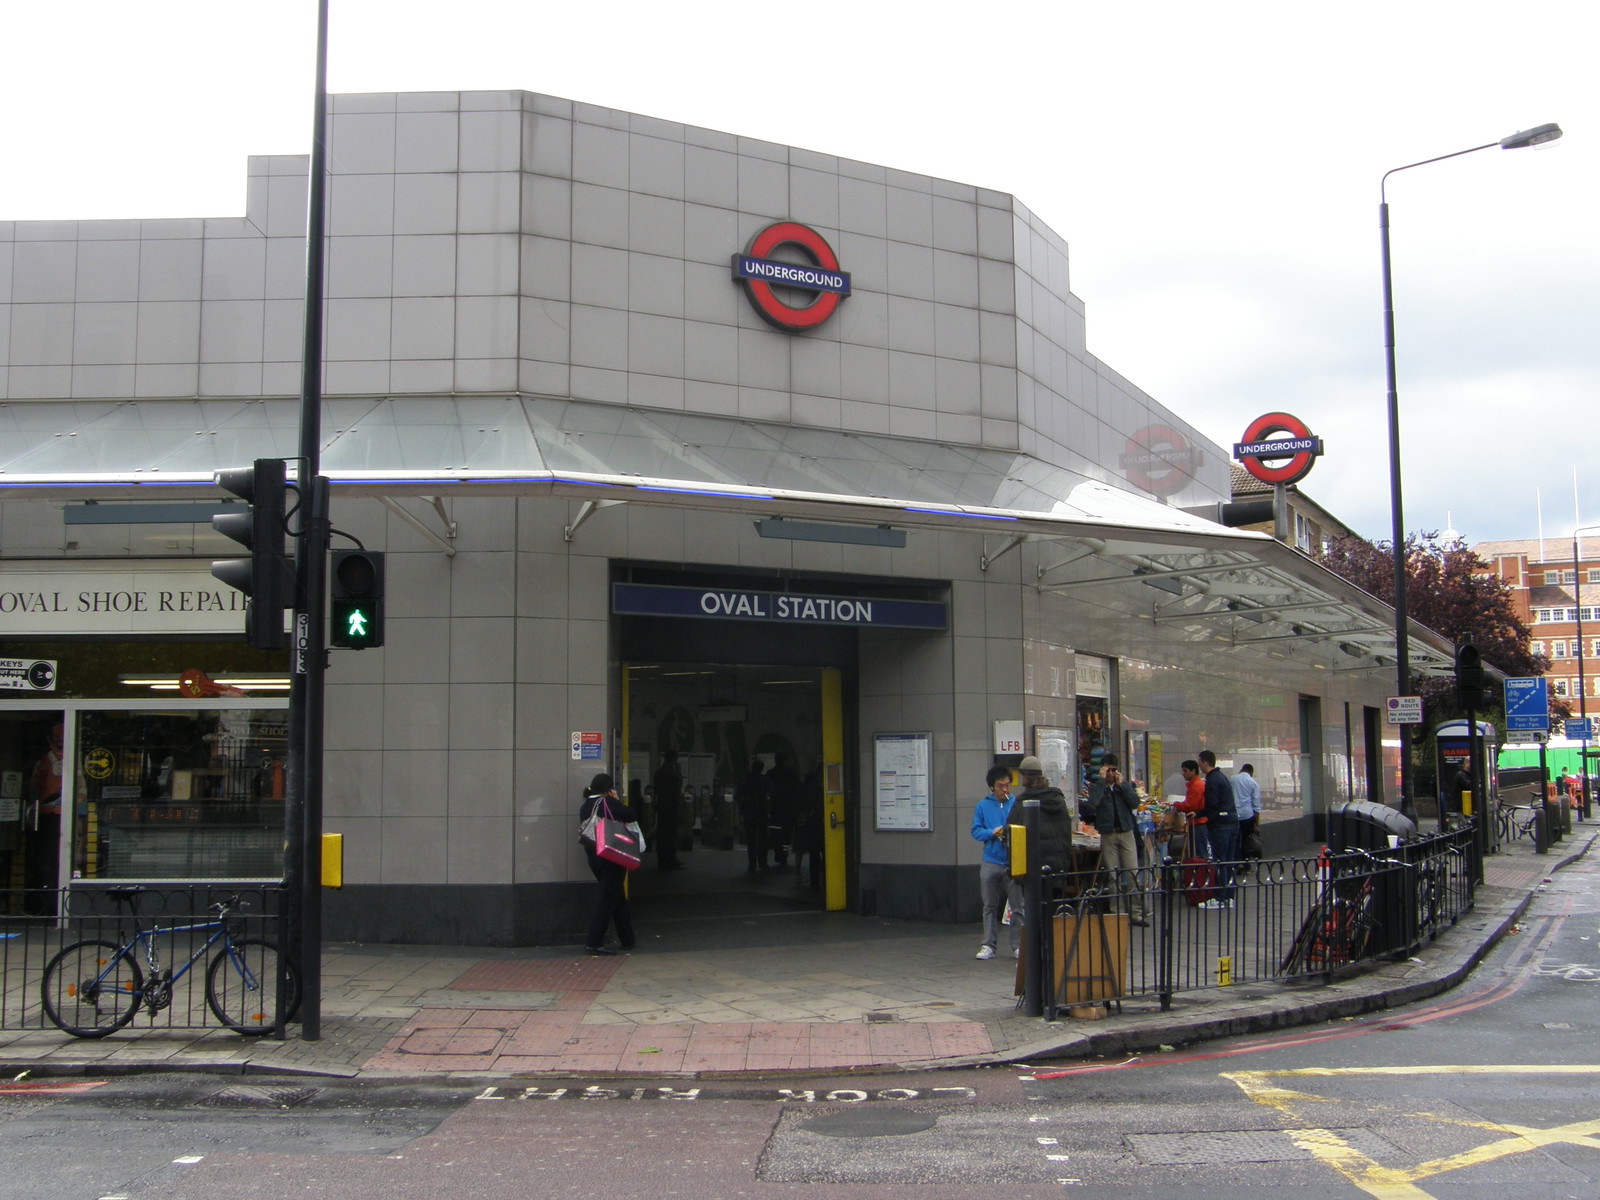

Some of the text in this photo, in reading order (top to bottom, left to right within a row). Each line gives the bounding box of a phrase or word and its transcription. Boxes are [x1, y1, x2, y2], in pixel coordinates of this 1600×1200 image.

[745, 261, 843, 288] UNDERGROUND
[1239, 440, 1312, 454] UNDERGROUND
[0, 592, 68, 612] OVAL
[78, 591, 148, 612] SHOE
[700, 592, 872, 622] OVAL STATION
[0, 660, 23, 668] KEYS
[1001, 740, 1020, 751] LFB
[475, 1085, 976, 1101] LOOK RIGHT
